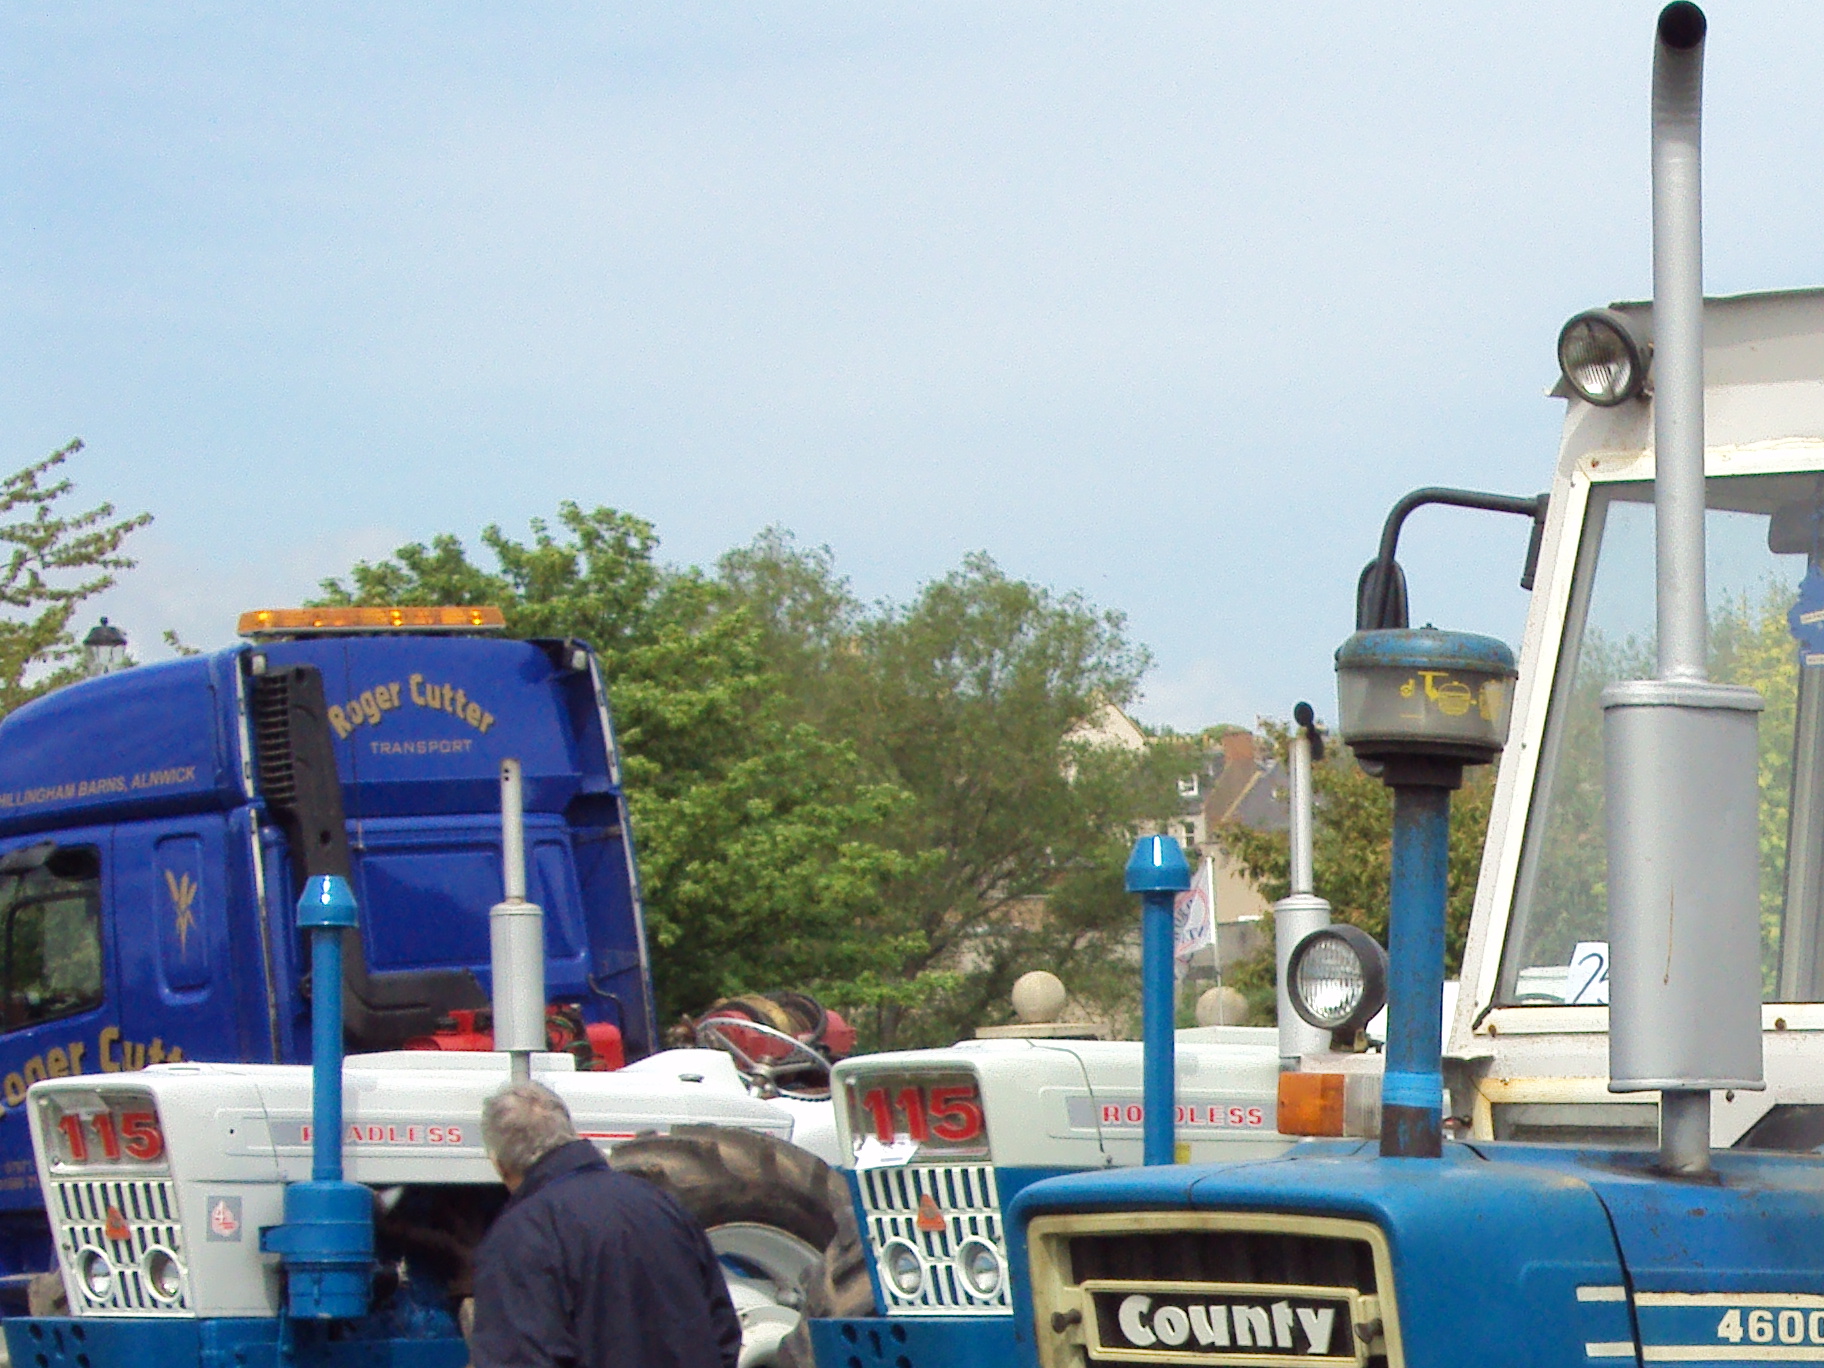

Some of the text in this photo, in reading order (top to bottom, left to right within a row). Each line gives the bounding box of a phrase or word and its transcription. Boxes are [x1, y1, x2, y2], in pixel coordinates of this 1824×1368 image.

[327, 672, 495, 740] Roger Cutter
[370, 738, 473, 755] TRANSPORT
[131, 765, 197, 790] ALNWICK
[58, 1112, 164, 1161] 115
[863, 1086, 983, 1143] 115
[1118, 1294, 1336, 1355] County
